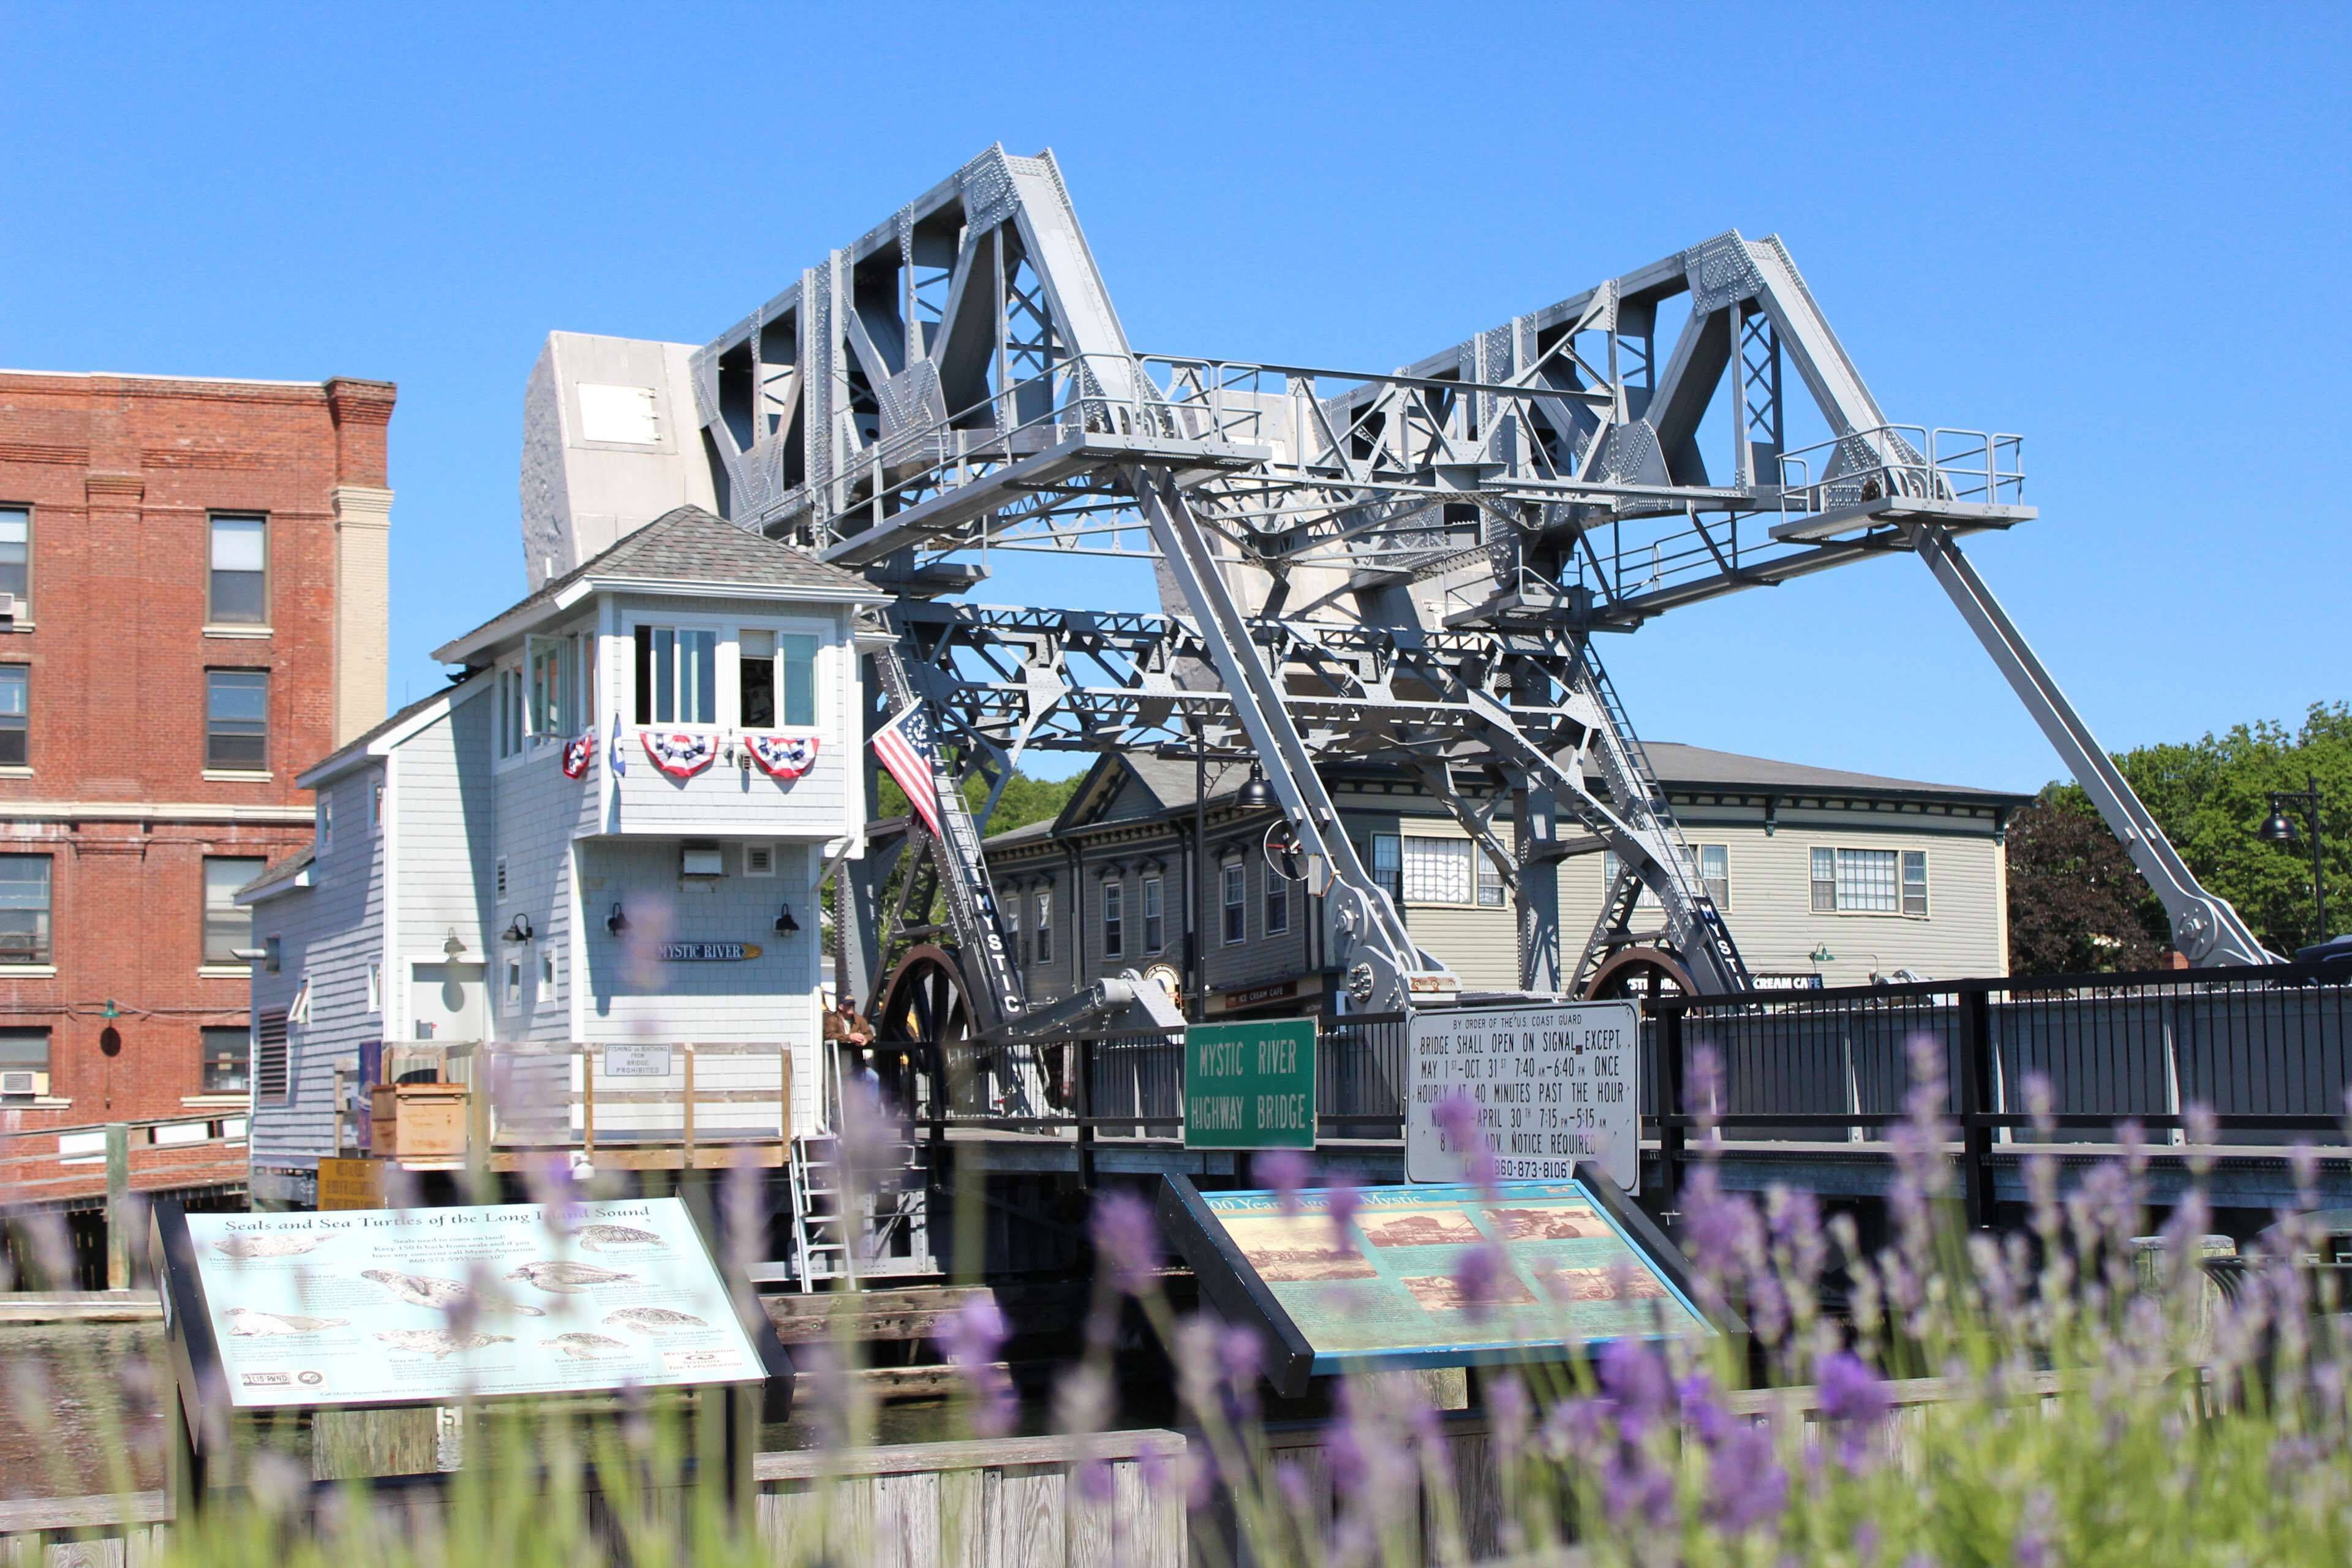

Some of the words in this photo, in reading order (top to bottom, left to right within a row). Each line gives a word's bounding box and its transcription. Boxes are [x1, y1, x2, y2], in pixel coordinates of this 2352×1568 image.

[658, 945, 699, 958] MYSTIC
[704, 944, 741, 958] RIVER
[974, 893, 1020, 1012] MYSTIC
[1752, 977, 1792, 989] CREAM
[1793, 977, 1820, 989] CAFE
[1250, 989, 1268, 1001] CREAM
[1270, 987, 1283, 997] CAFE
[1453, 1020, 1461, 1030] BY
[1465, 1019, 1485, 1029] ORDER
[1489, 1018, 1497, 1028] OF
[1501, 1017, 1512, 1028] THE
[1517, 1017, 1528, 1027] U.S.
[1532, 1016, 1553, 1027] COAST
[1559, 1014, 1581, 1025] GUARD
[1420, 1036, 1449, 1055] BRIDGE
[1457, 1035, 1483, 1054] SHALL
[1491, 1033, 1514, 1053] OPEN
[1523, 1032, 1534, 1052] ON
[1543, 1031, 1575, 1052] SIGNAL
[1585, 1030, 1620, 1050] EXCEPT
[1199, 1041, 1243, 1077] MYSTIC
[1258, 1039, 1297, 1074] RIVER
[1421, 1060, 1438, 1079] MAY
[1515, 1058, 1534, 1078] 7:40
[1594, 1056, 1619, 1077] ONCE
[1417, 1084, 1449, 1103] HOURLY
[1458, 1084, 1467, 1102] AT
[1475, 1084, 1485, 1103] 40
[1494, 1083, 1530, 1103] MINUTES
[1539, 1082, 1562, 1103] PAST
[1572, 1082, 1588, 1103] THE
[1597, 1082, 1623, 1103] HOUR
[1191, 1096, 1244, 1129] HIGHWAY
[1257, 1094, 1305, 1129] BRIDGE
[1540, 1109, 1557, 1128] 7:15
[1441, 1133, 1445, 1152] 8
[1485, 1133, 1504, 1153] ADV.
[1512, 1133, 1542, 1153] NOTICE
[1551, 1134, 1596, 1155] REQUIRED
[1209, 1200, 1235, 1210] 00
[1359, 1194, 1424, 1206] Mystic
[225, 1221, 272, 1231] Seals
[278, 1219, 312, 1230] and
[320, 1219, 351, 1229] Sea
[358, 1216, 423, 1227] Turtles
[429, 1213, 447, 1227] of
[451, 1213, 477, 1224] the
[484, 1212, 530, 1225] Long
[595, 1206, 650, 1218] Sound
